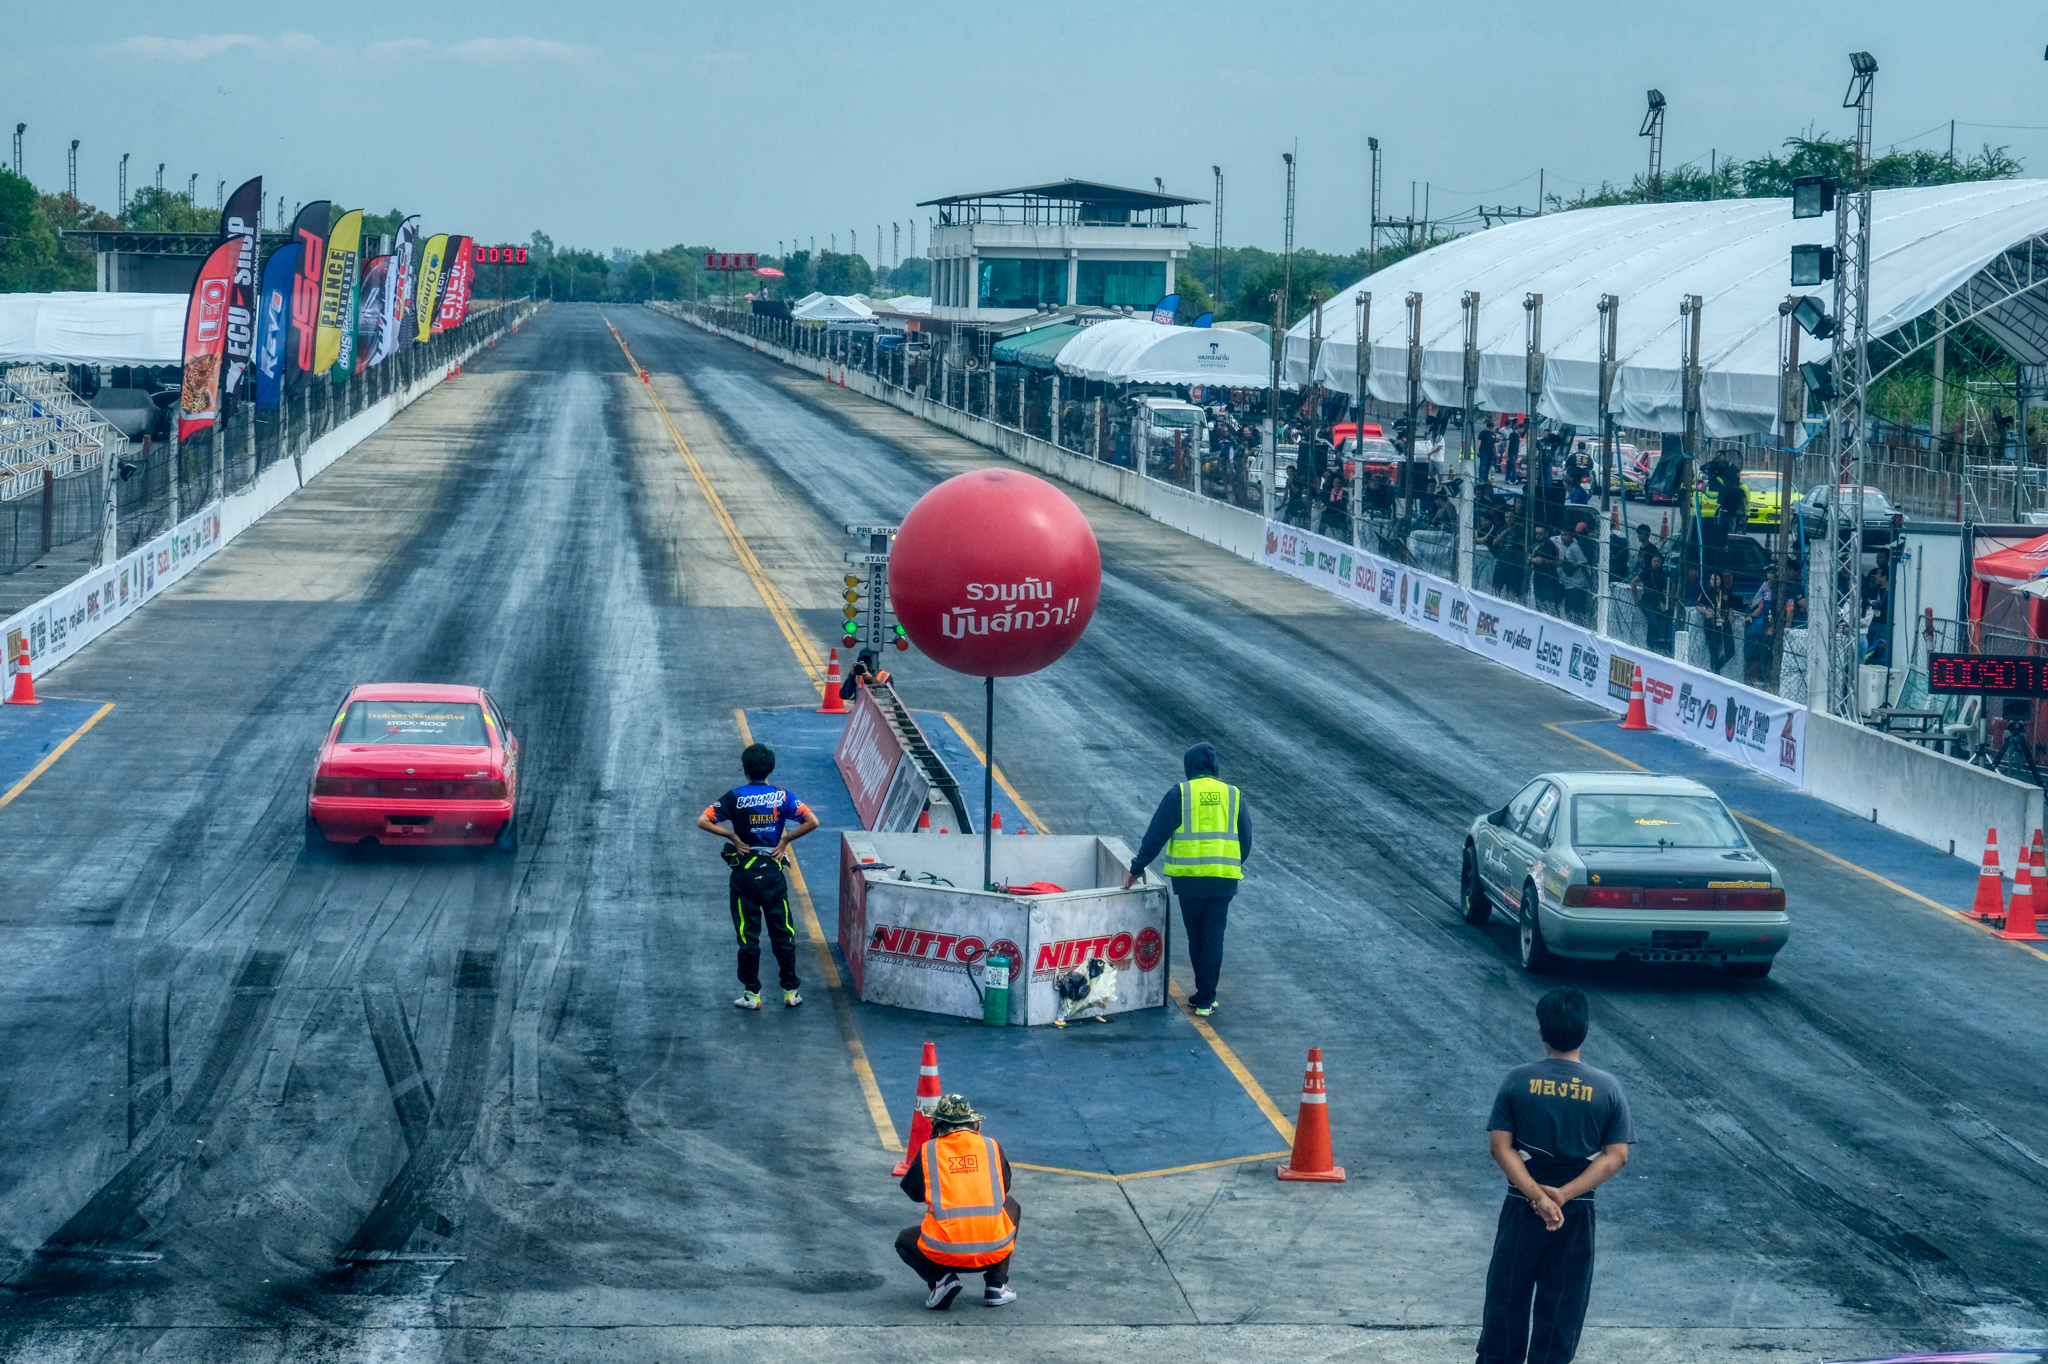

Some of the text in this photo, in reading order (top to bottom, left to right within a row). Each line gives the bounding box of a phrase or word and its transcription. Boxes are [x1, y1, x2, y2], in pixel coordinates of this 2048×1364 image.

[321, 250, 346, 326] PRINCE
[335, 252, 355, 328] LUBRICANTS
[199, 280, 228, 341] LEO
[1153, 315, 1172, 324] MOLY
[1155, 308, 1174, 318] LIQUI
[226, 307, 251, 357] ECU
[856, 527, 899, 535] PRE-STAG
[966, 577, 1053, 601] รวมกัน
[1355, 565, 1376, 593] ISUZU
[1477, 610, 1500, 635] BRC
[1781, 739, 1796, 769] LEO
[736, 790, 786, 809] BANGMOD
[1200, 791, 1220, 802] XO
[869, 924, 986, 964] NITTO
[1033, 931, 1134, 972] NITTO
[865, 954, 985, 976] RACING PERFORMANCE
[949, 1154, 979, 1169] XO
